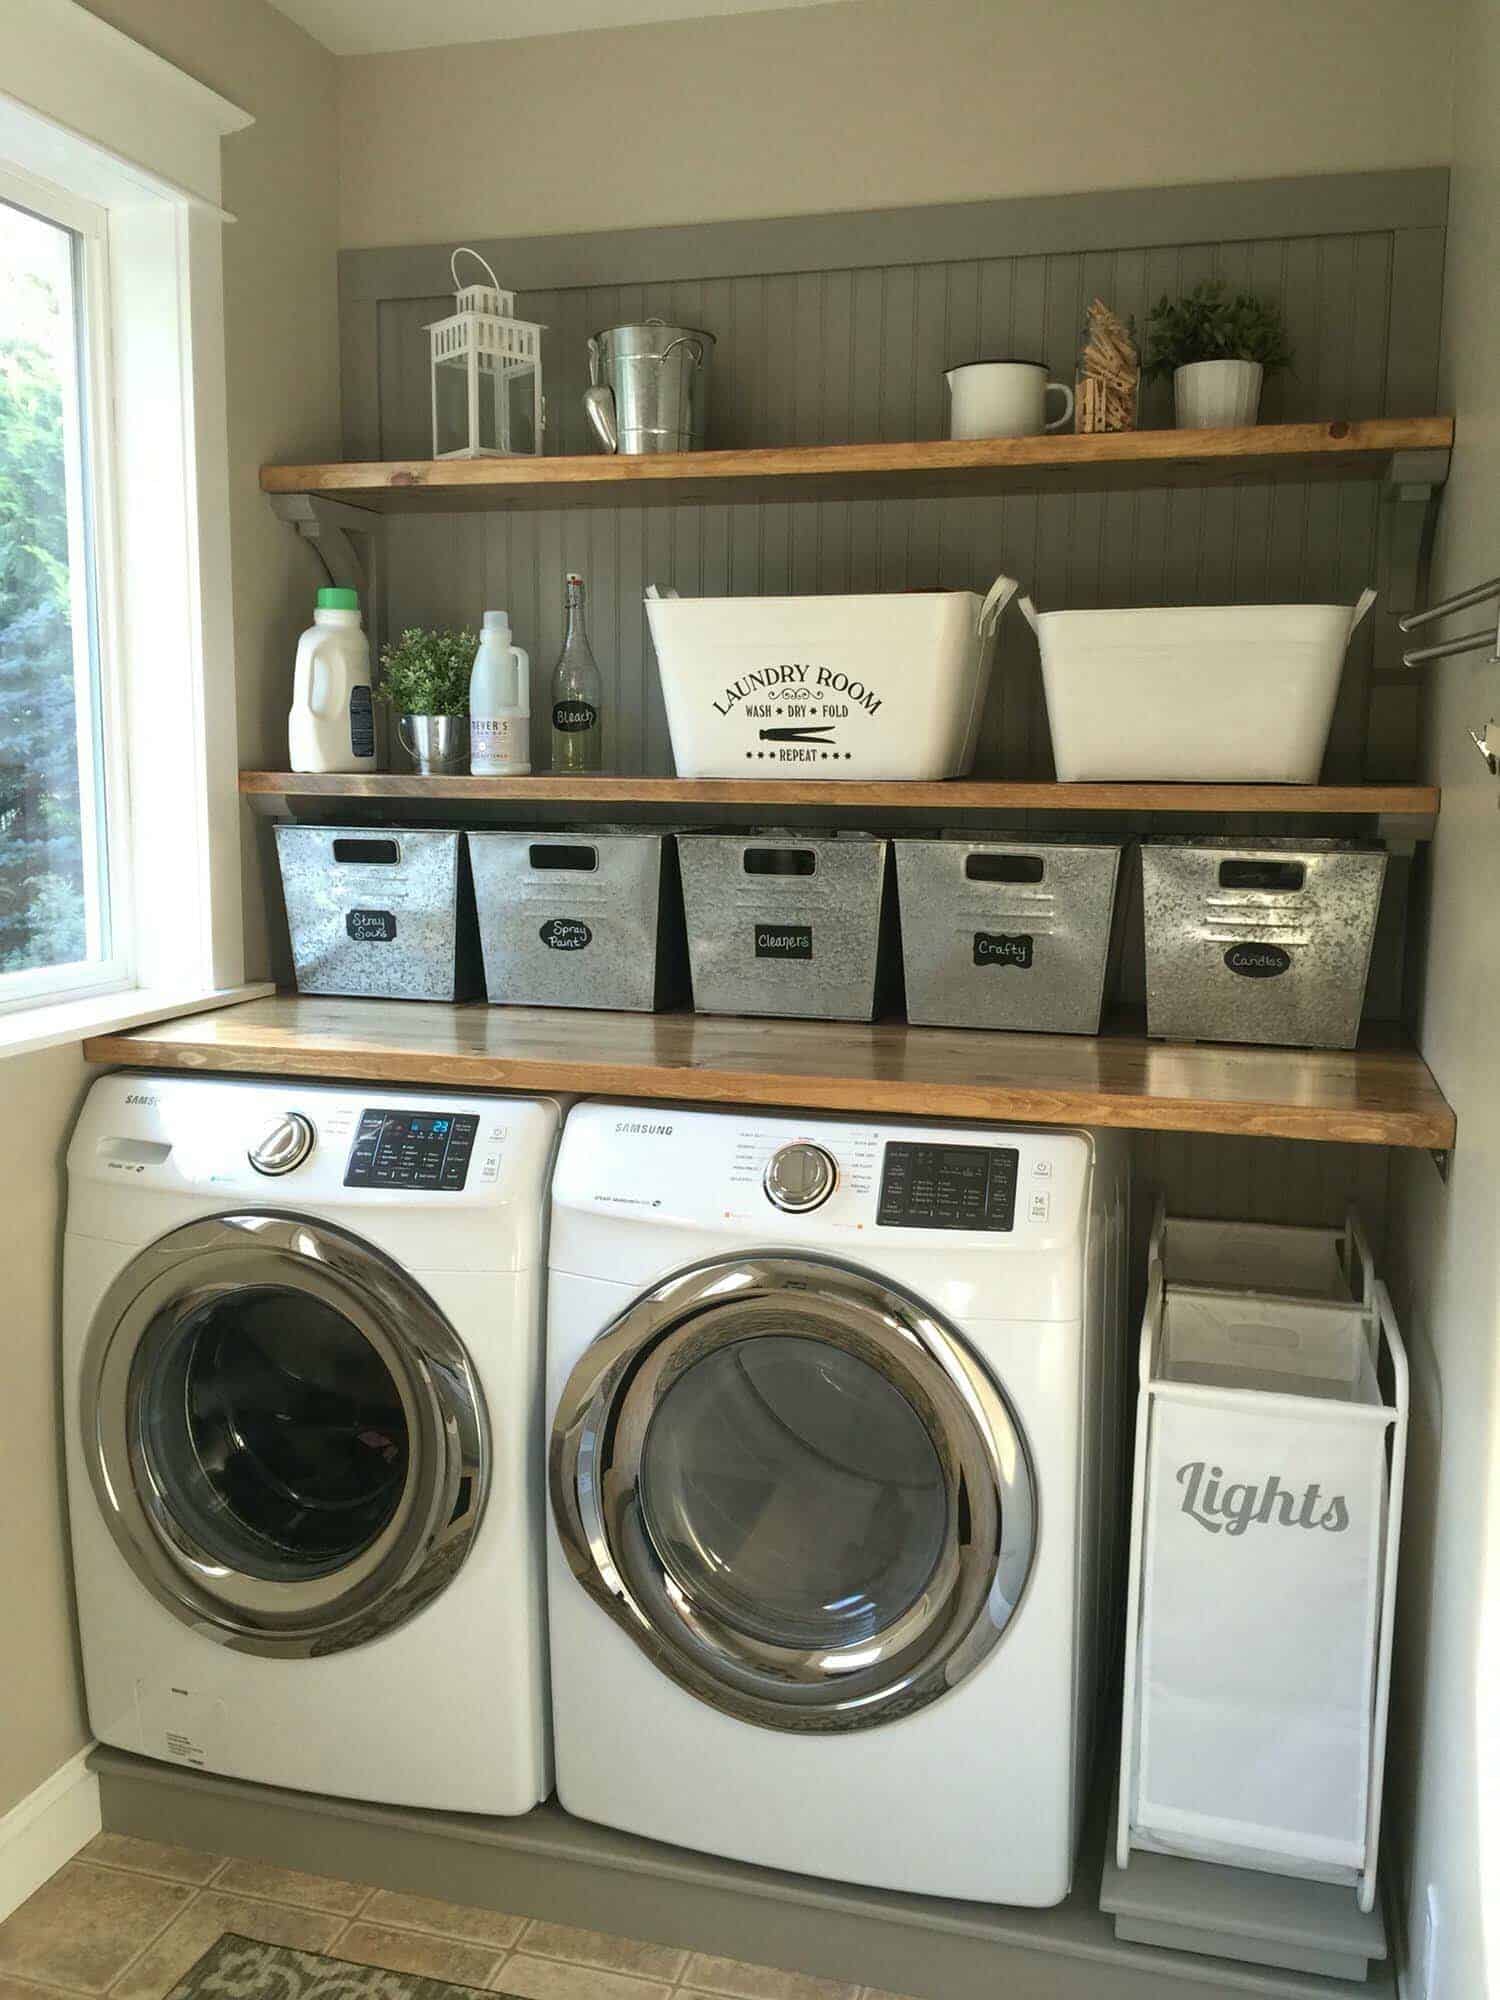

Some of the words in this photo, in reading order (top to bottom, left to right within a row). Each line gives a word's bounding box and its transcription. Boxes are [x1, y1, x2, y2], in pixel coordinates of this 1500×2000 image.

[712, 664, 810, 716] LAUNDRY
[816, 667, 882, 716] ROOM
[745, 704, 772, 717] WASH
[788, 705, 806, 717] DRY
[823, 705, 849, 718] FOLD
[556, 709, 593, 729] Bleach
[779, 749, 817, 762] REPEAT
[352, 912, 385, 931] Stray
[354, 926, 388, 940] Socks
[552, 920, 588, 941] Spray
[547, 935, 580, 947] Paint
[758, 934, 809, 950] Cleaners
[978, 940, 1026, 962] Crafty
[1232, 952, 1283, 967] Candles
[432, 1119, 450, 1133] 23
[615, 1122, 674, 1135] SAMSUNG
[1175, 1461, 1350, 1537] Lights
